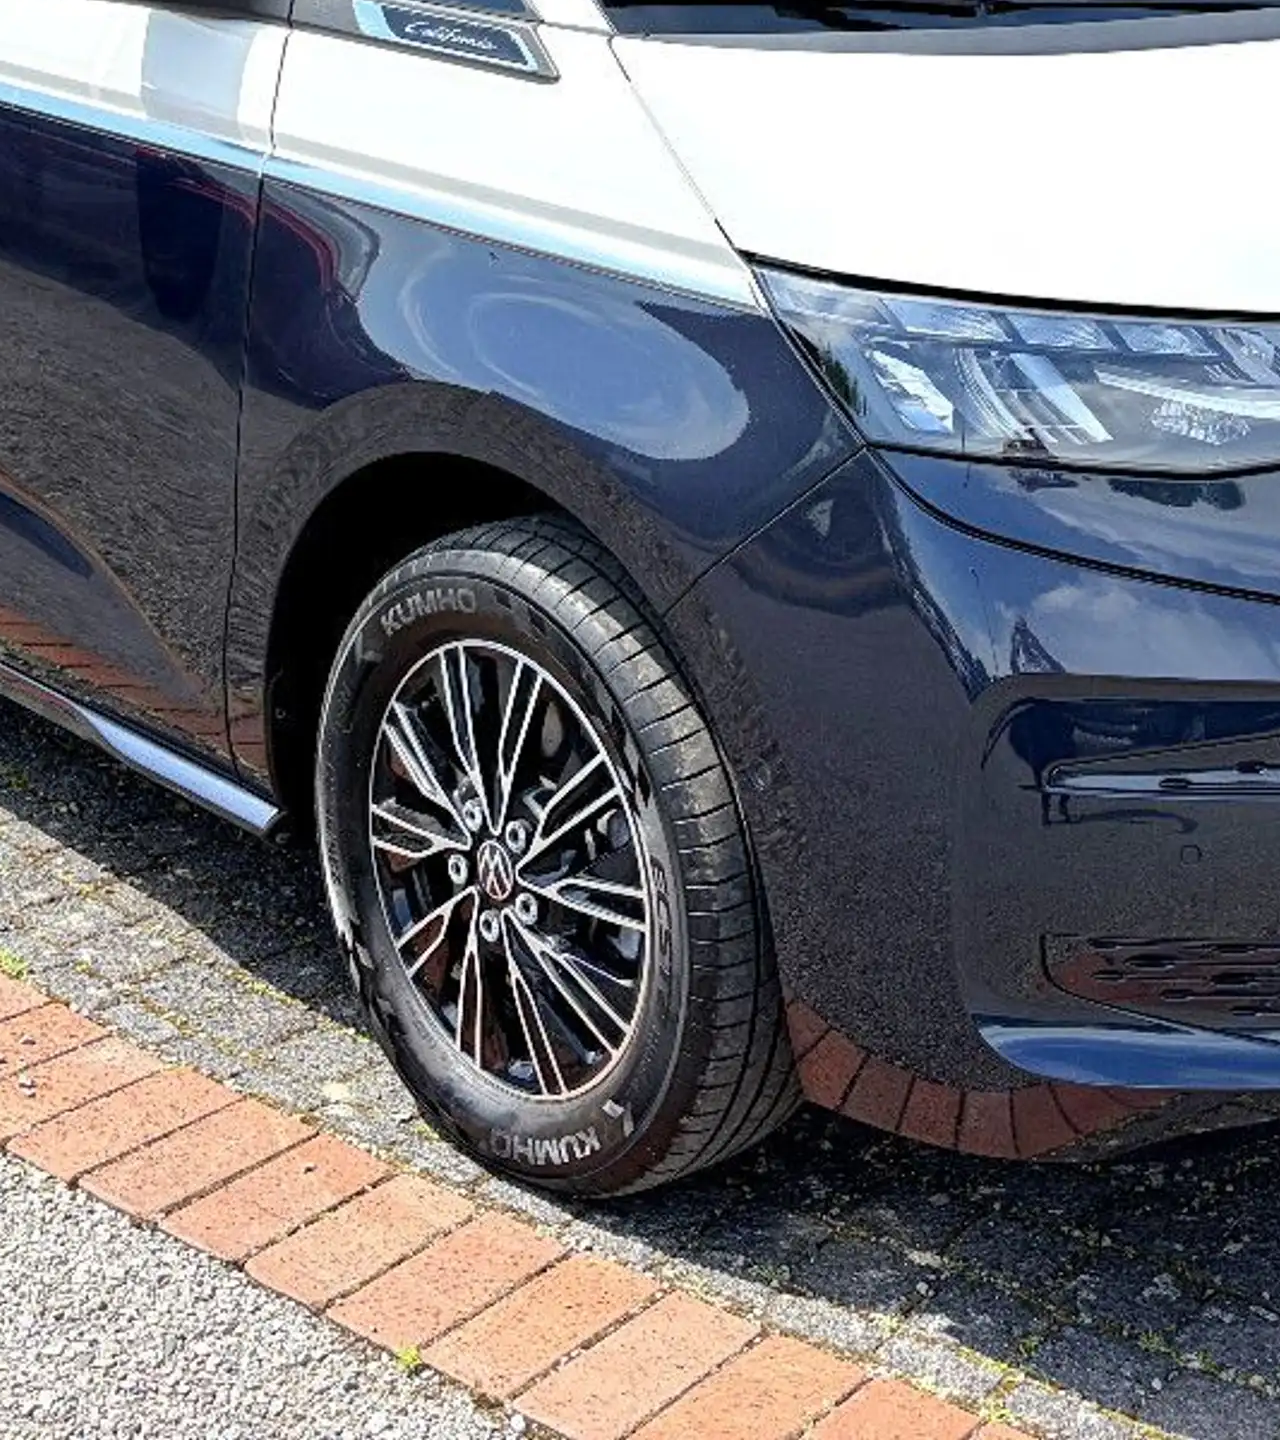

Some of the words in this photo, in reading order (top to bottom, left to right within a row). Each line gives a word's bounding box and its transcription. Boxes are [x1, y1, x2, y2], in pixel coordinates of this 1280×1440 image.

[404, 21, 498, 50] California
[381, 588, 476, 637] KUMHO
[490, 1126, 602, 1166] KUMHO
